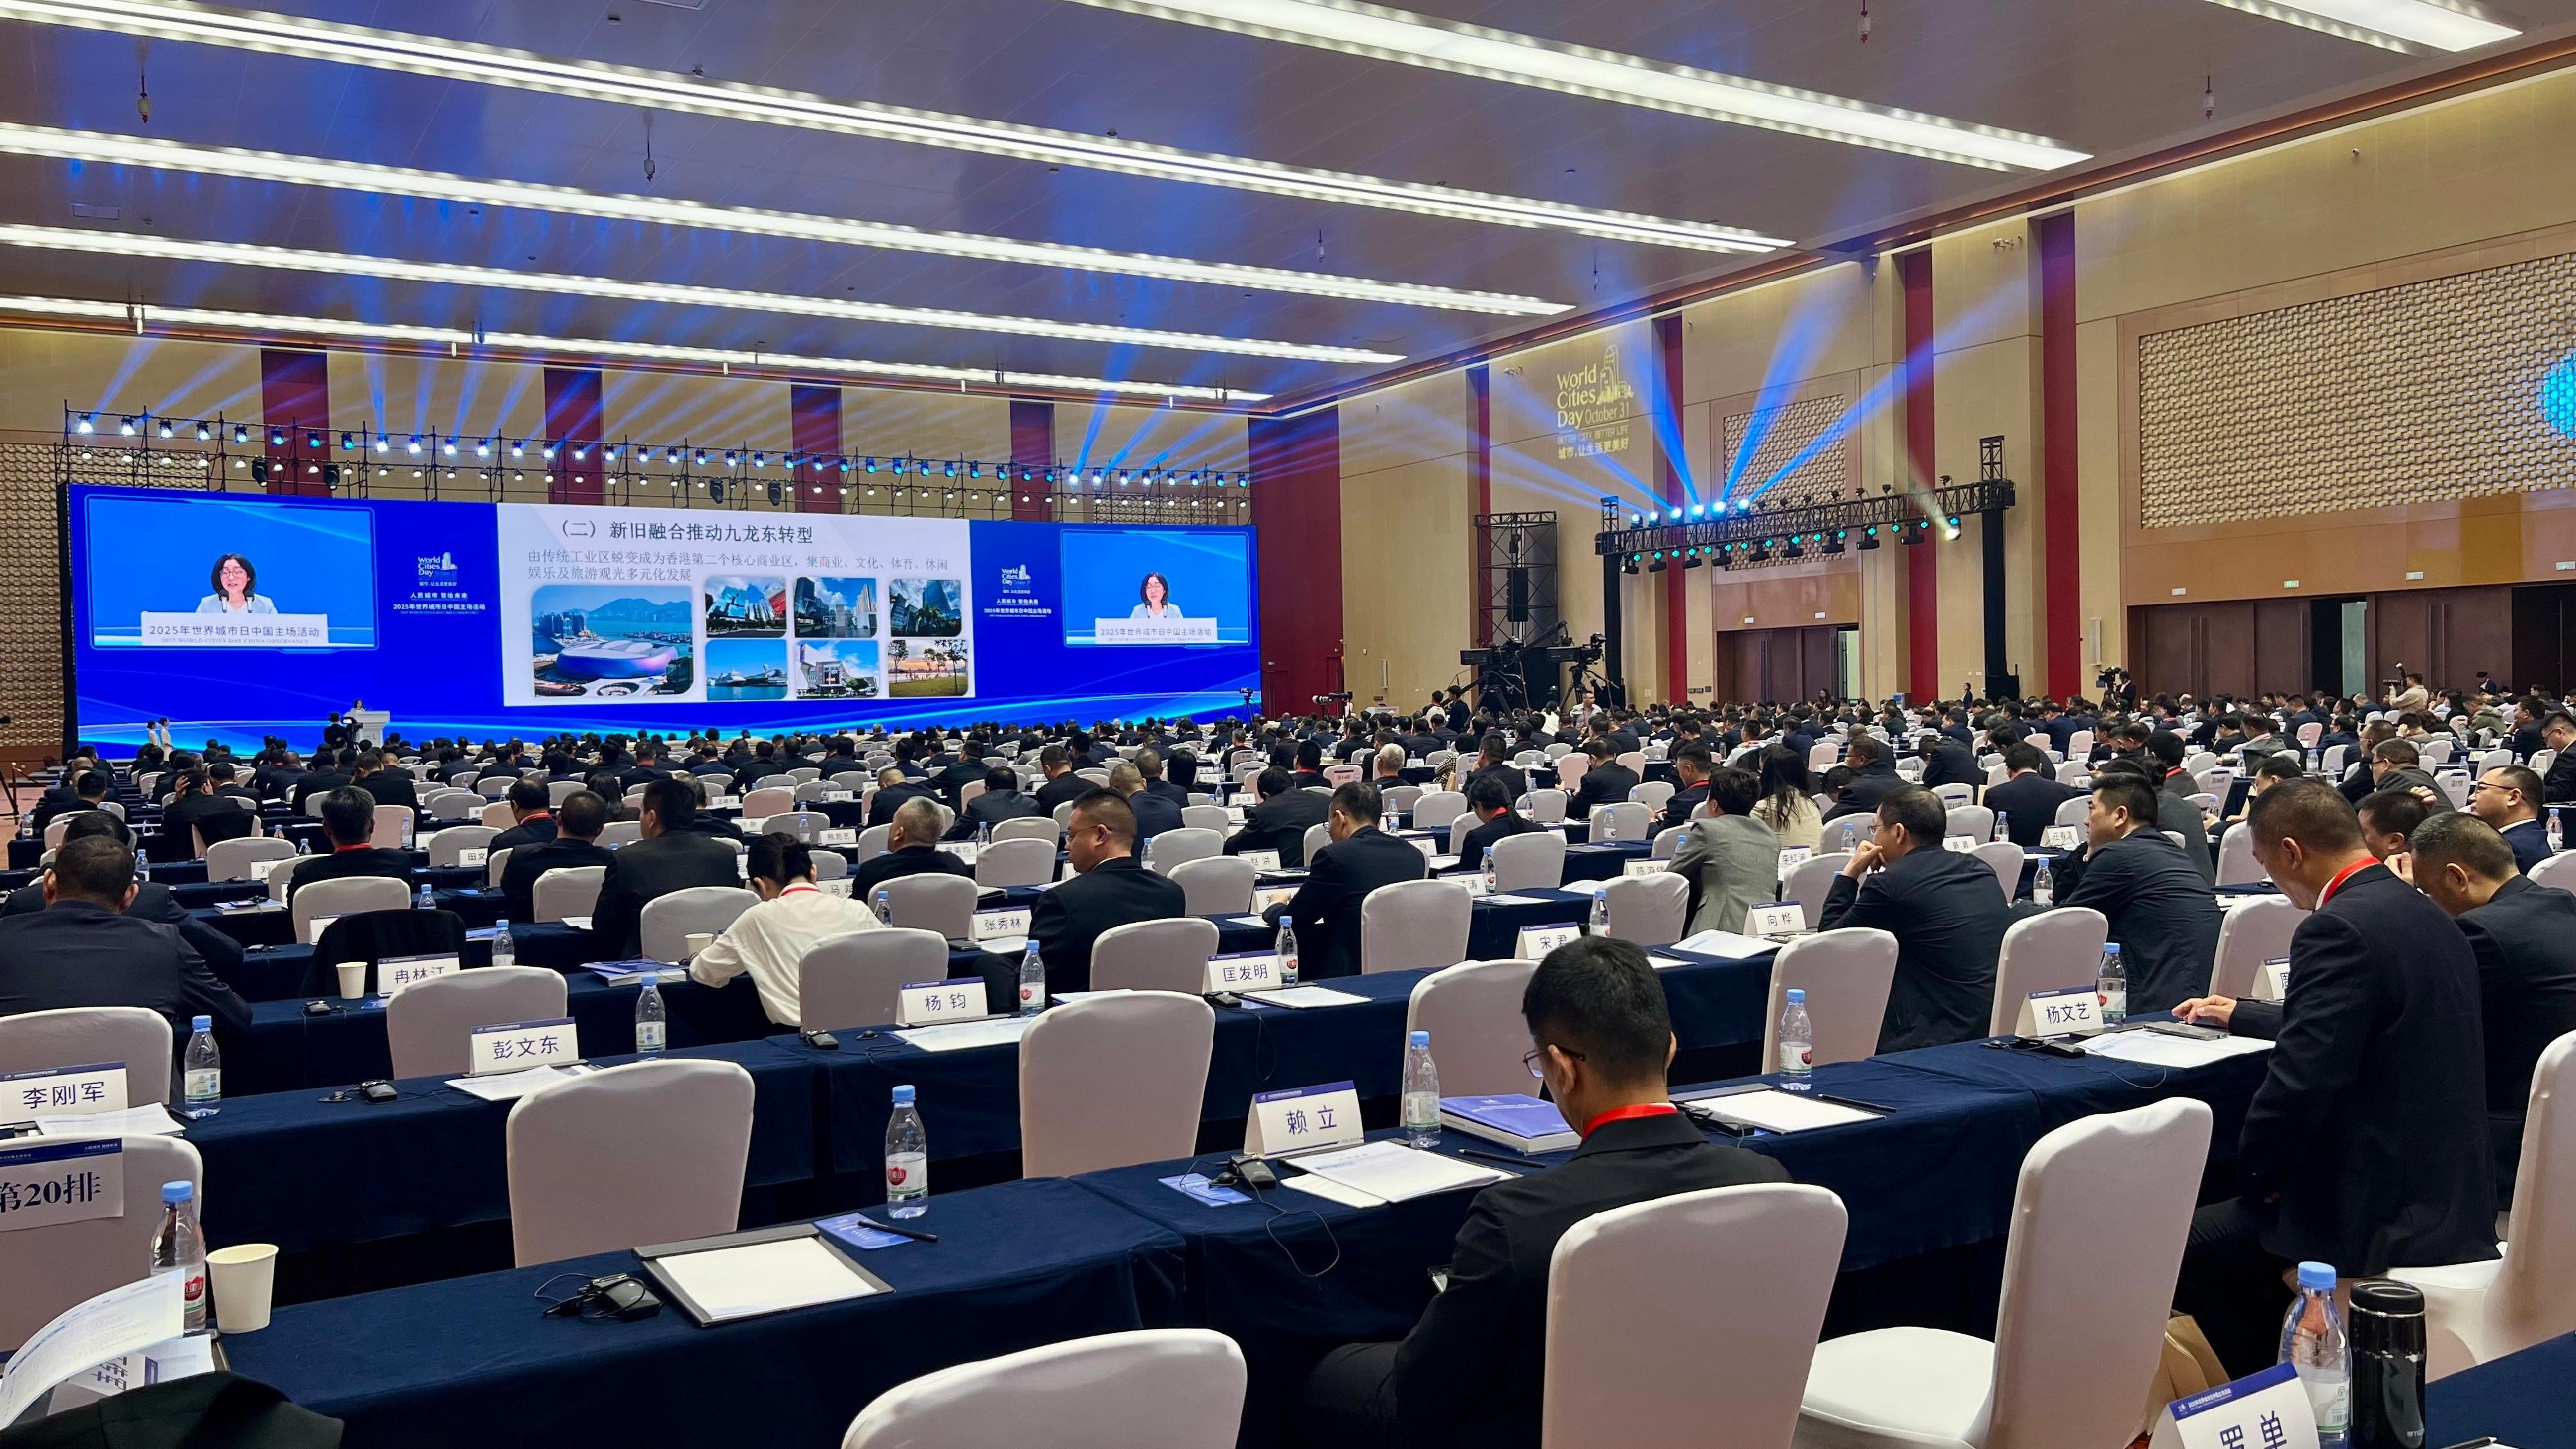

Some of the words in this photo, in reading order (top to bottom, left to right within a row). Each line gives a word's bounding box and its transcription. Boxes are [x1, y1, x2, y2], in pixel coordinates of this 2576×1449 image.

[1557, 363, 1596, 390] World
[1557, 387, 1596, 410] Cities
[1558, 410, 1584, 430] Day
[1585, 406, 1617, 424] October
[1619, 401, 1629, 418] 31
[1595, 428, 1615, 439] BETTER
[1616, 425, 1629, 435] LIFE
[528, 566, 692, 582] 娱乐及旅游观光多元化发展
[149, 625, 320, 638] 2025年世界城市日中国主场活动
[984, 916, 1022, 931] 张秀林
[1223, 964, 1268, 982] 匡发明
[2046, 1001, 2090, 1024] 杨文艺
[493, 1035, 559, 1060] 彭文东
[23, 1081, 105, 1109] 李刚军
